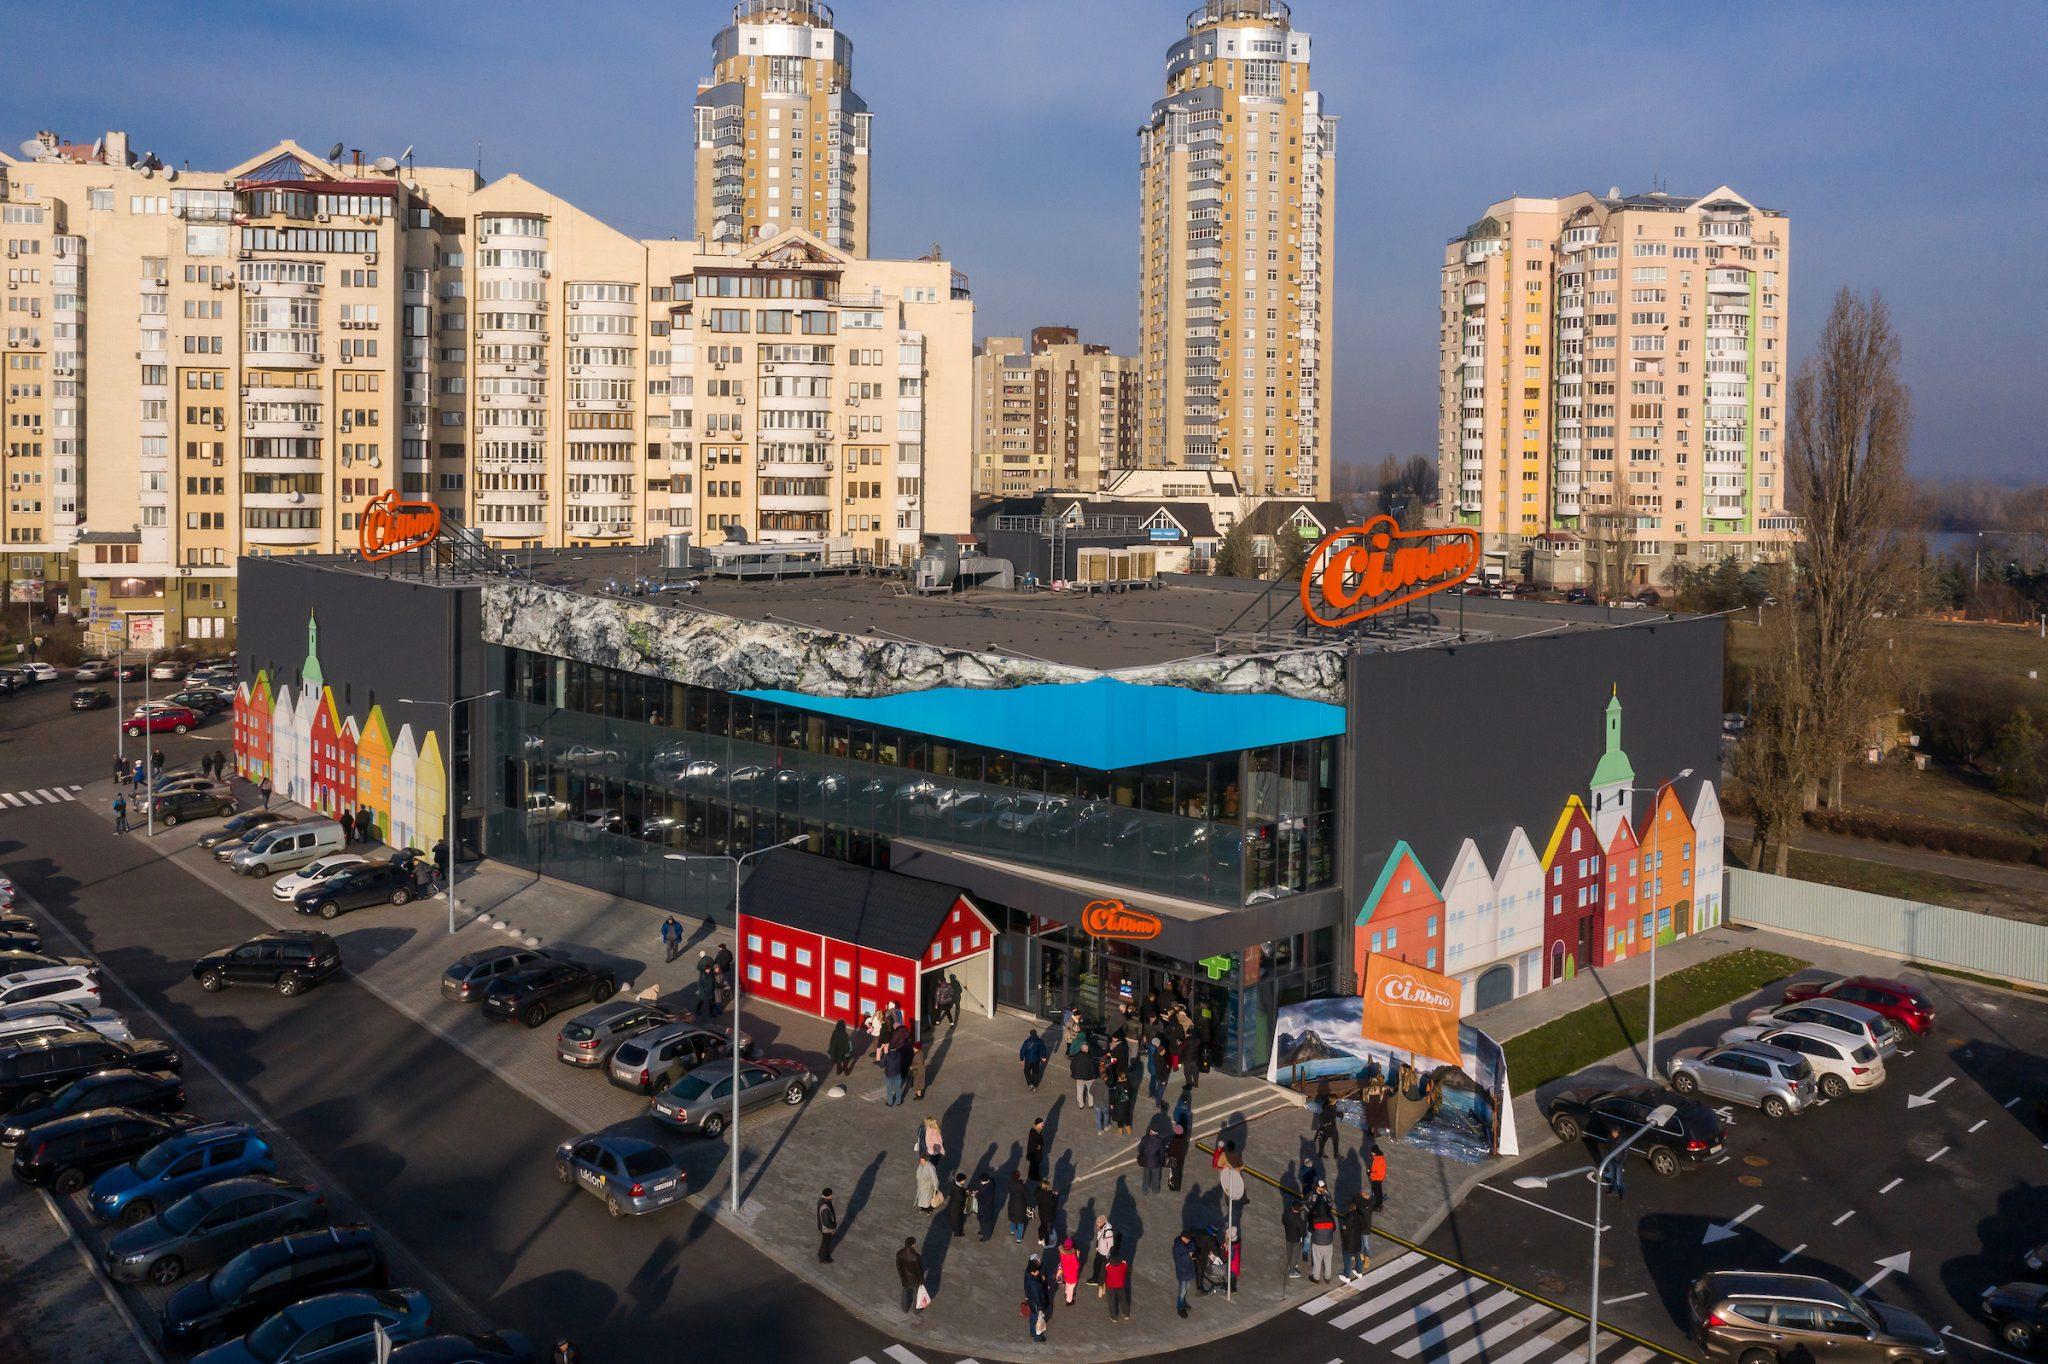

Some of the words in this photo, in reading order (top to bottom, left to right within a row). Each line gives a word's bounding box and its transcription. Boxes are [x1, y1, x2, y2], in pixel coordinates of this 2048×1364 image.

[1090, 908, 1154, 933] Сільпо
[1385, 980, 1450, 1007] Сільпо
[580, 1168, 602, 1188] uklon
[657, 1196, 674, 1205] uklon
